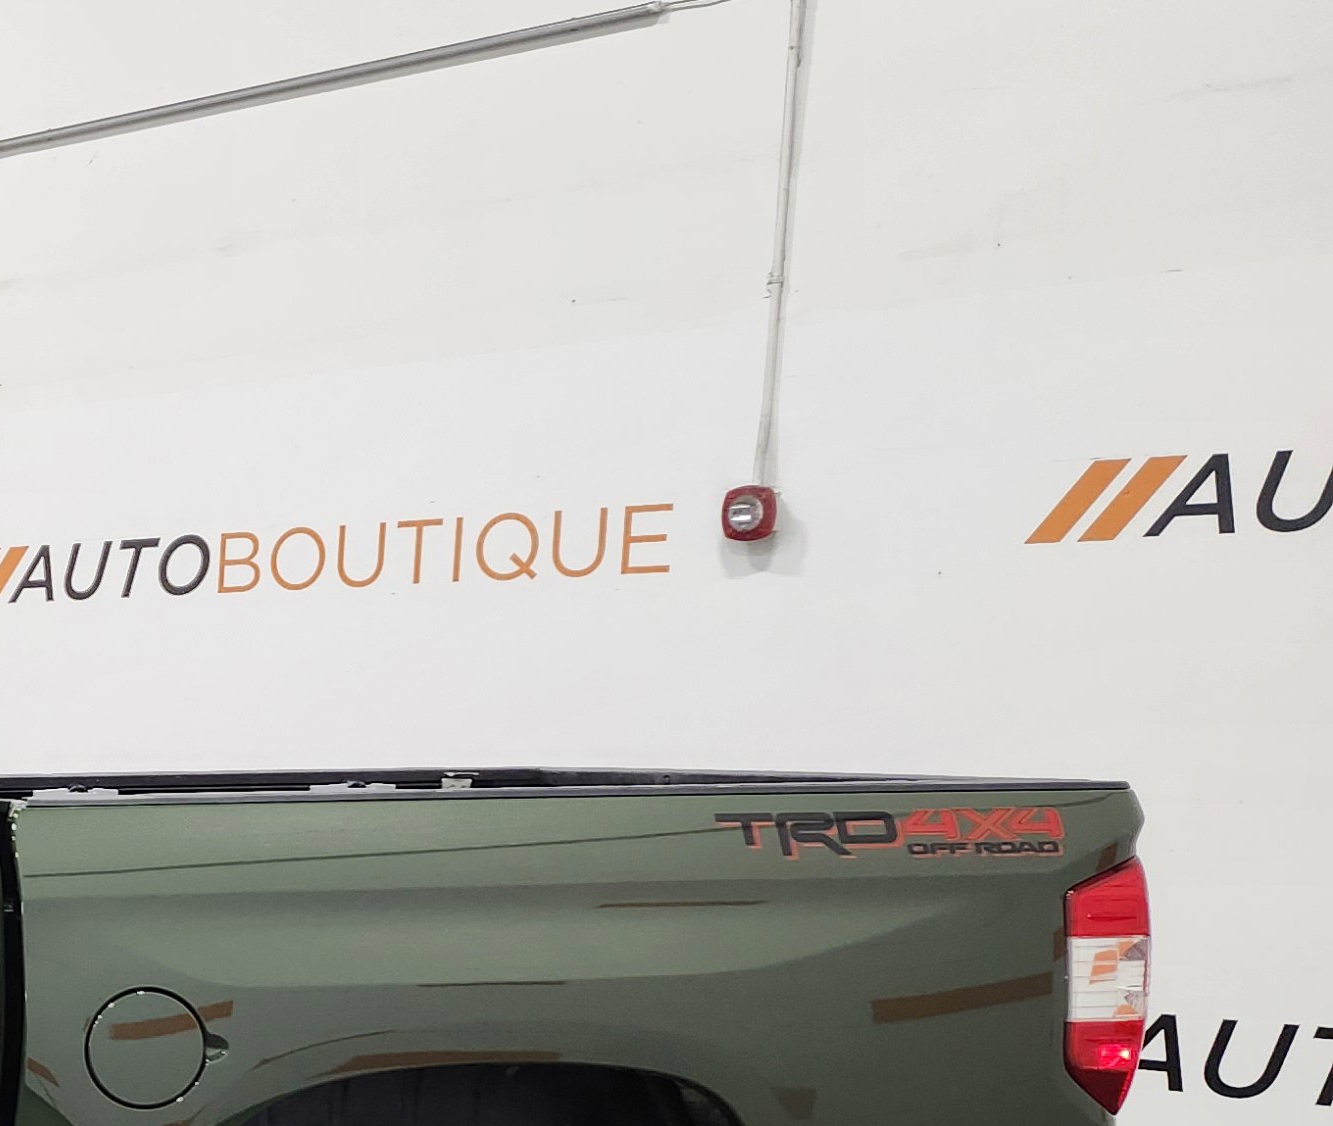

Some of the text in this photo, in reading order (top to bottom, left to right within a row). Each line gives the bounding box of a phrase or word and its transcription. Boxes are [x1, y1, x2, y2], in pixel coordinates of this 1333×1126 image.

[9, 502, 674, 604] AUTOBOUTIQUE
[714, 811, 901, 858] TRD
[974, 841, 1064, 857] ROAD
